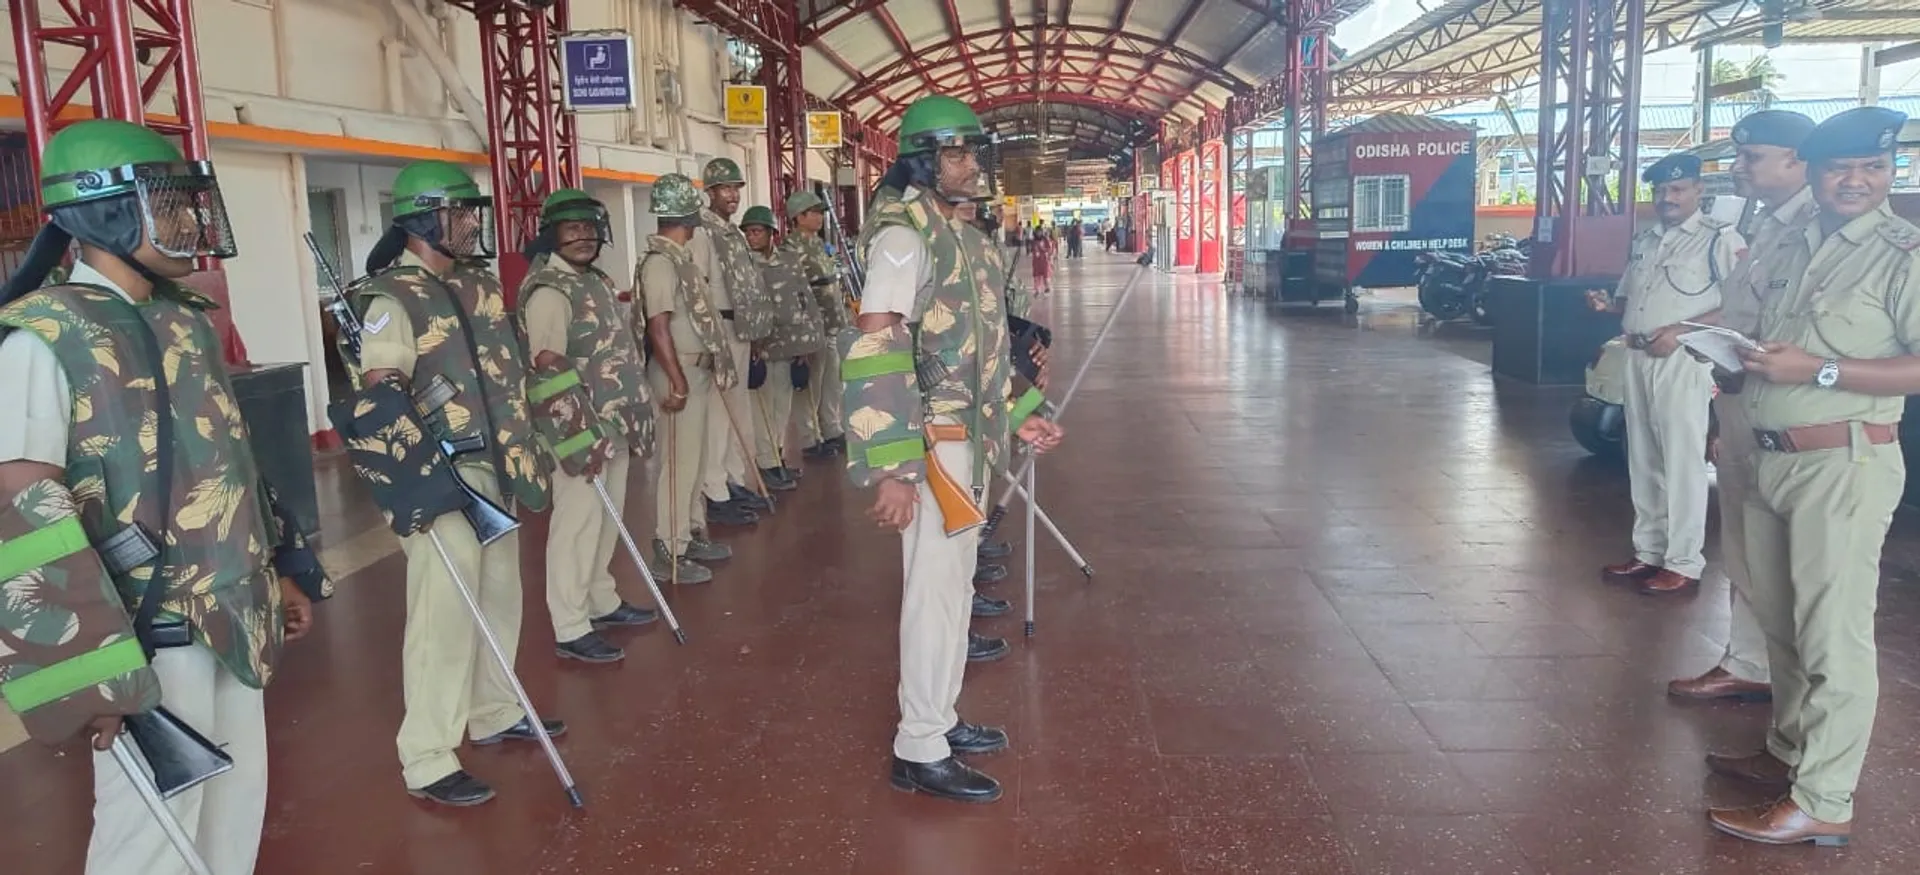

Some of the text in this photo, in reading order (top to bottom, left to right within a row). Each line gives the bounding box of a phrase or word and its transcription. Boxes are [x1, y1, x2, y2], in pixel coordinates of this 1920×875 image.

[1356, 142, 1470, 158] ODISHA POLICE
[1355, 240, 1383, 251] WOMEN
[1390, 240, 1428, 251] CHILDREN
[1428, 238, 1447, 249] HELP
[1447, 238, 1468, 249] DESK
